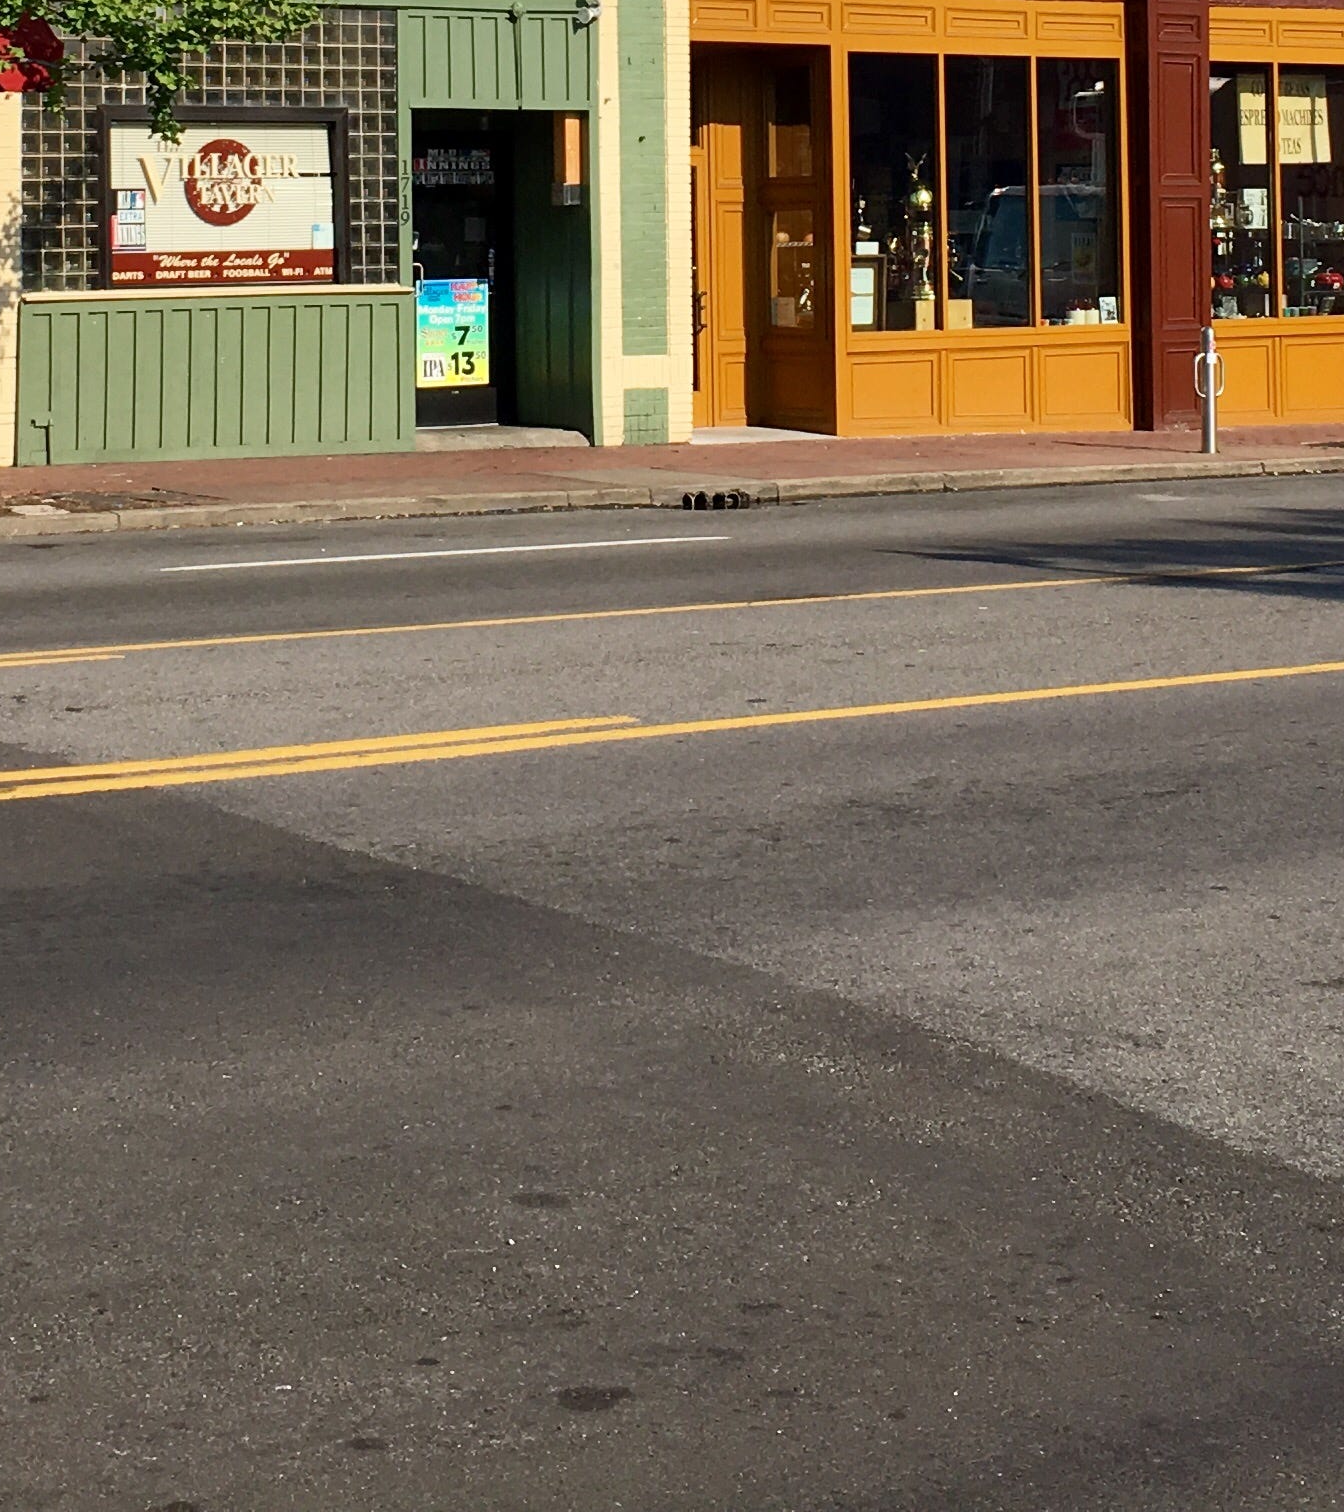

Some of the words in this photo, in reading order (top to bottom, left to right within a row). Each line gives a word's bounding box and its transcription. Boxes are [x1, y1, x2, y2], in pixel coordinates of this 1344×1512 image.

[1281, 138, 1302, 155] TEAS
[136, 152, 299, 205] VILLAGER
[197, 180, 275, 205] TAVERN
[400, 160, 410, 226] 1719
[201, 255, 219, 266] the
[223, 254, 263, 266] Locals
[112, 271, 144, 281] DARTS
[156, 270, 186, 279] DRAFT
[188, 270, 211, 279] BEER
[223, 268, 270, 278] FOOSBALL
[313, 266, 333, 275] ATM
[423, 360, 445, 377] IPA
